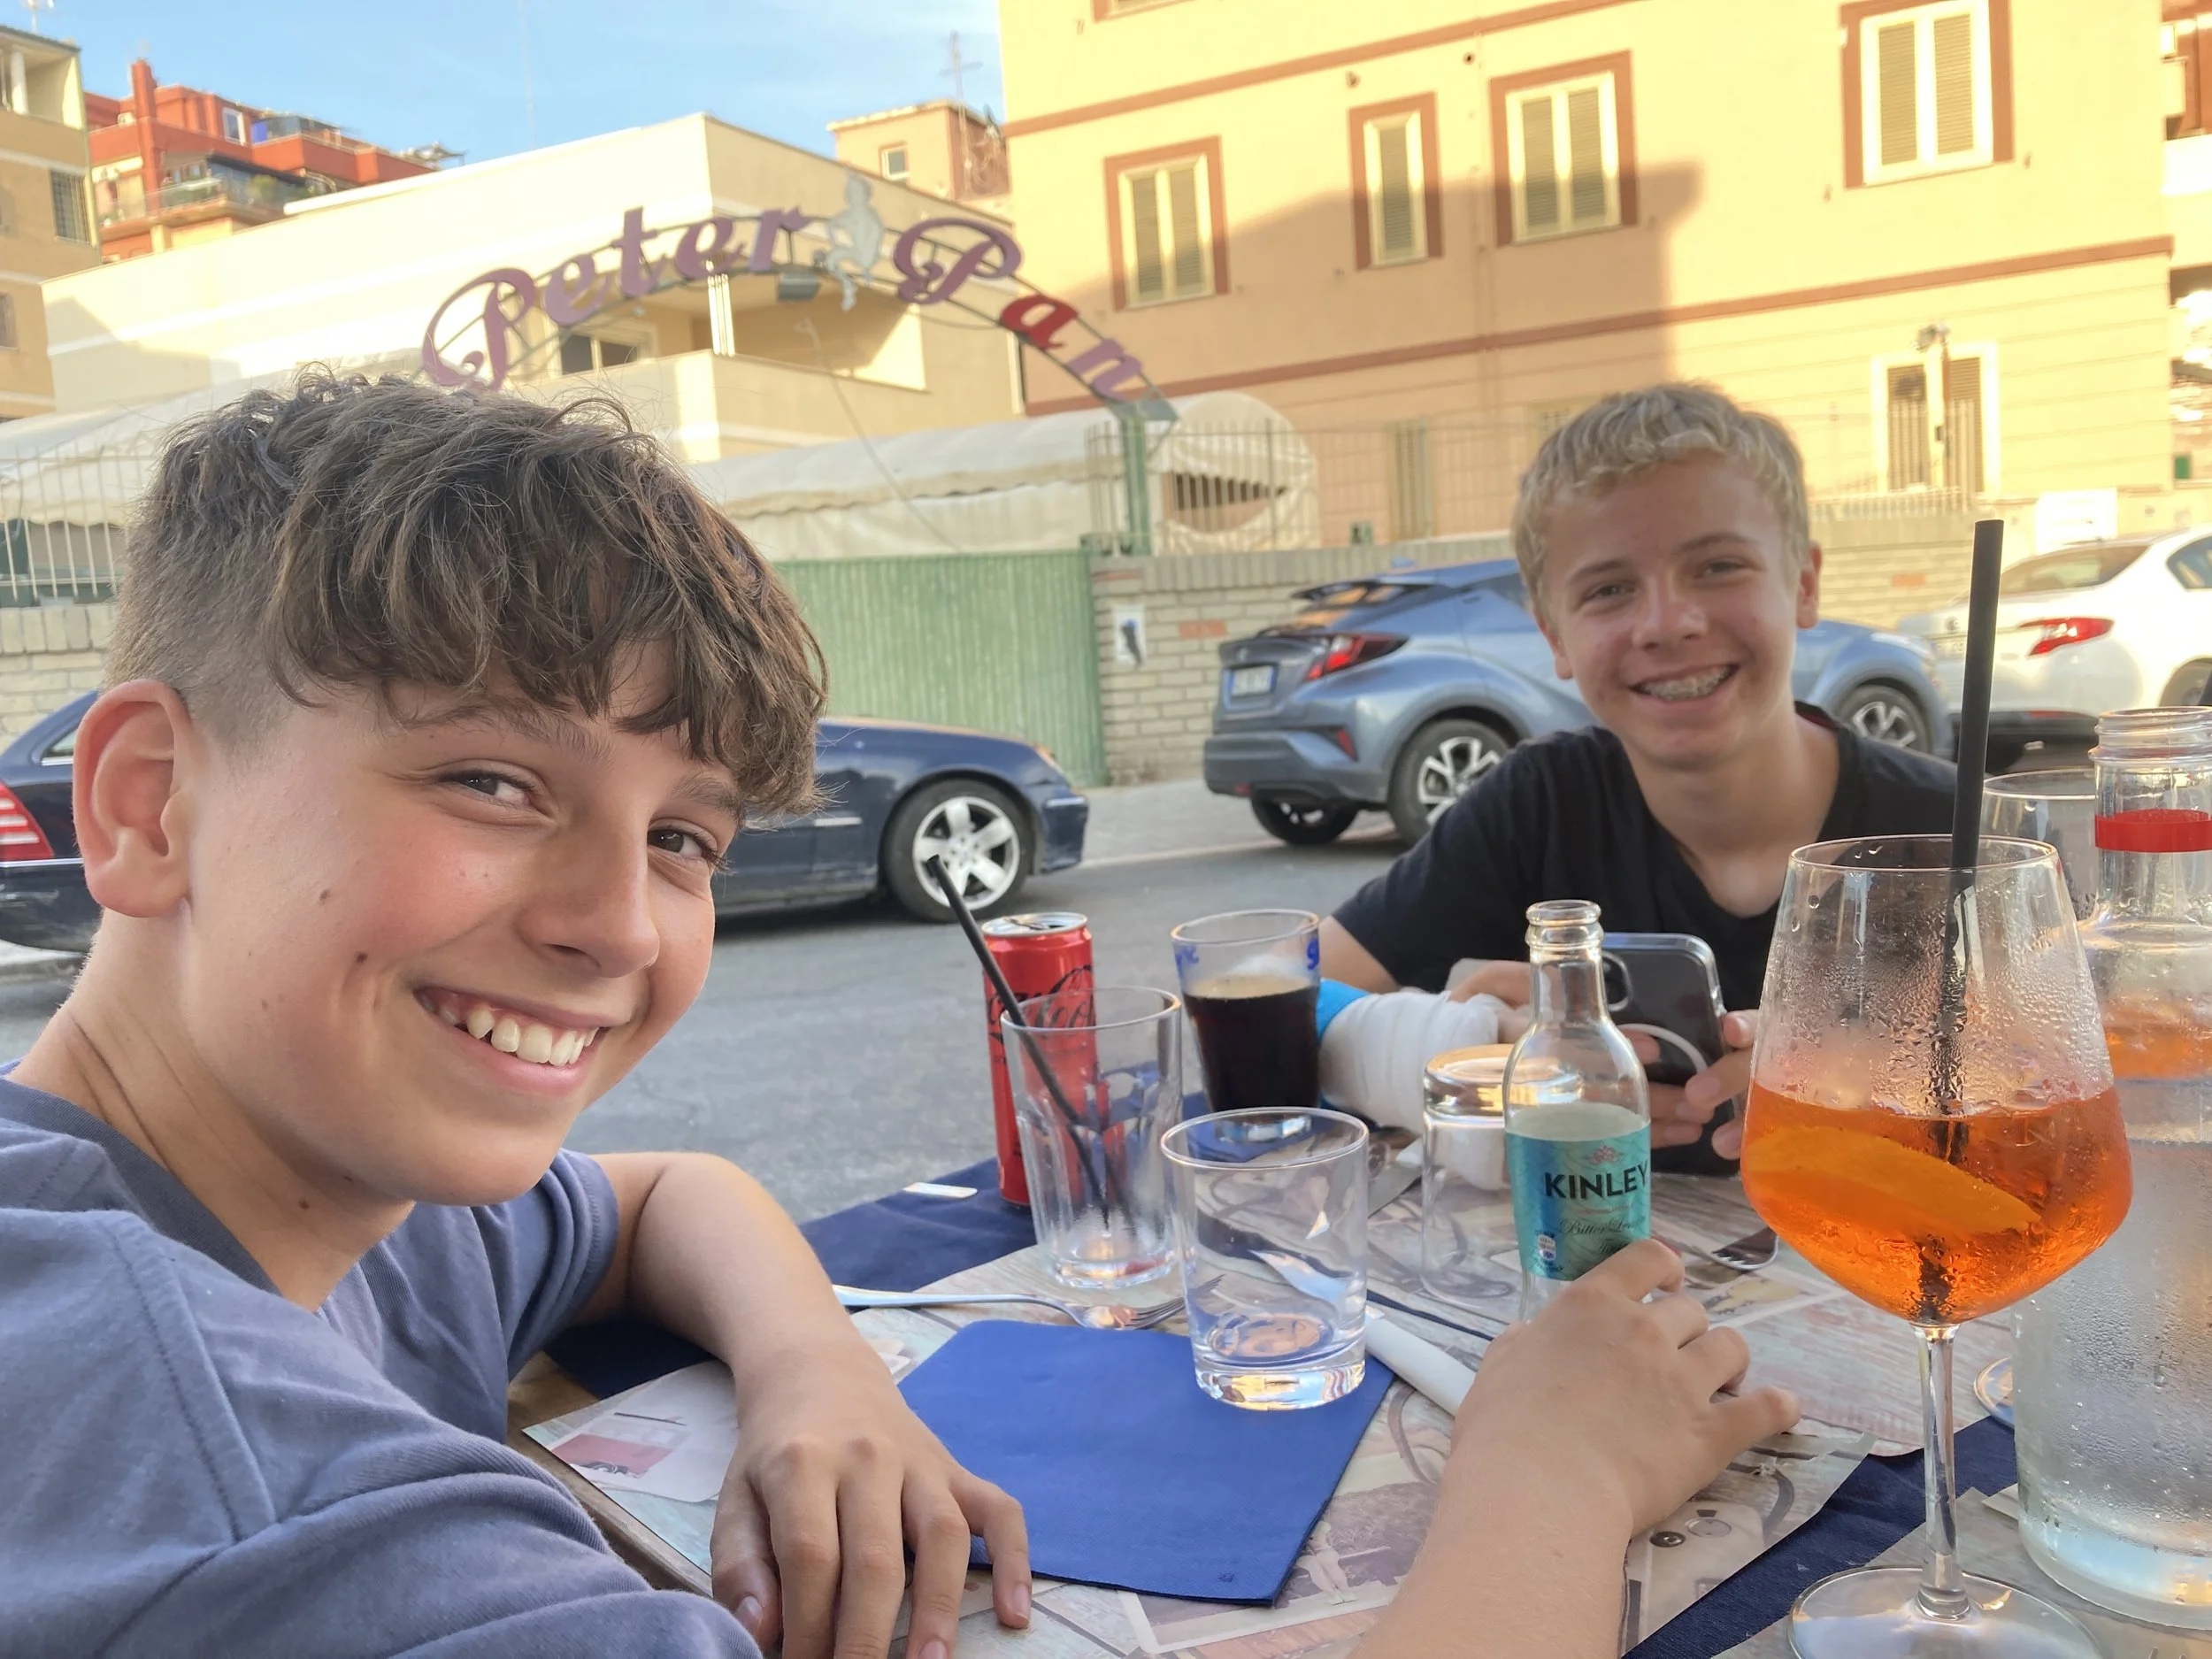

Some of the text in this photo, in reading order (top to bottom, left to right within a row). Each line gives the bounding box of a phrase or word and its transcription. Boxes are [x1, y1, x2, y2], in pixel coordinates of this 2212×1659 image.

[422, 207, 1156, 393] Peter Pan
[1545, 1160, 1648, 1199] KINLEY
